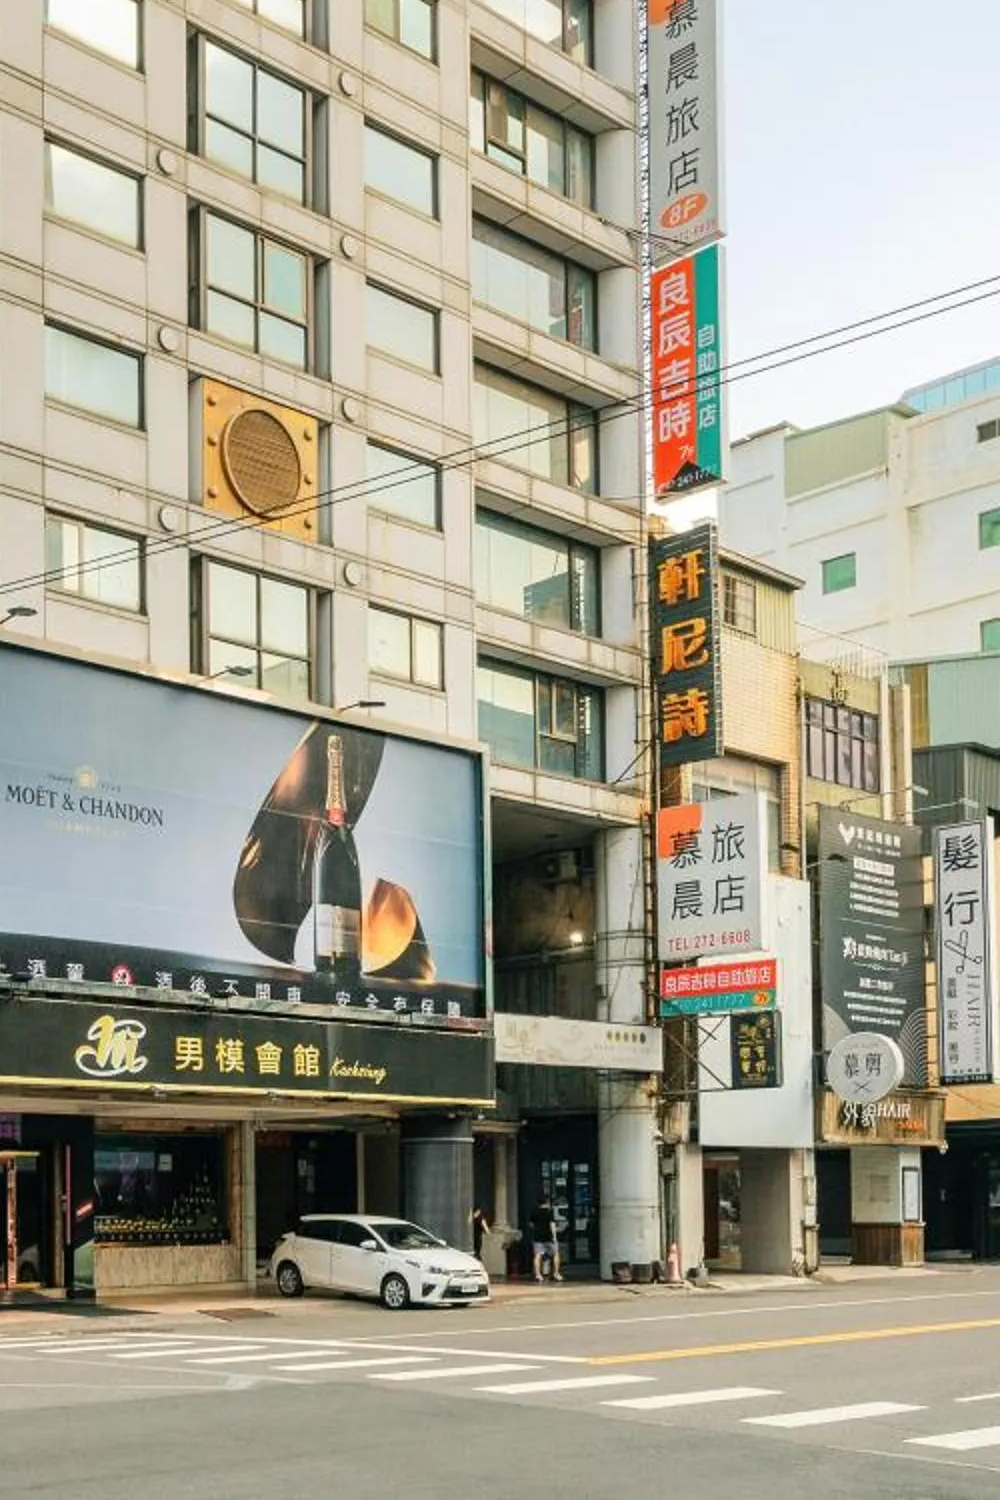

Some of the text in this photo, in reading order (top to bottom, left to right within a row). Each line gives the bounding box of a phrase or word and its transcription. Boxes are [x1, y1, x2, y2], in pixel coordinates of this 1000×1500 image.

[668, 195, 698, 225] 8F
[657, 272, 692, 444] 良辰吉時
[697, 323, 717, 432] 自助旅店
[656, 547, 710, 744] 軒尼詩
[6, 784, 164, 827] MOËT & CHANDON
[669, 827, 703, 921] 慕晨
[710, 820, 747, 916] 旅店
[943, 833, 981, 928] 髮行
[174, 1035, 321, 1078] 男模會館
